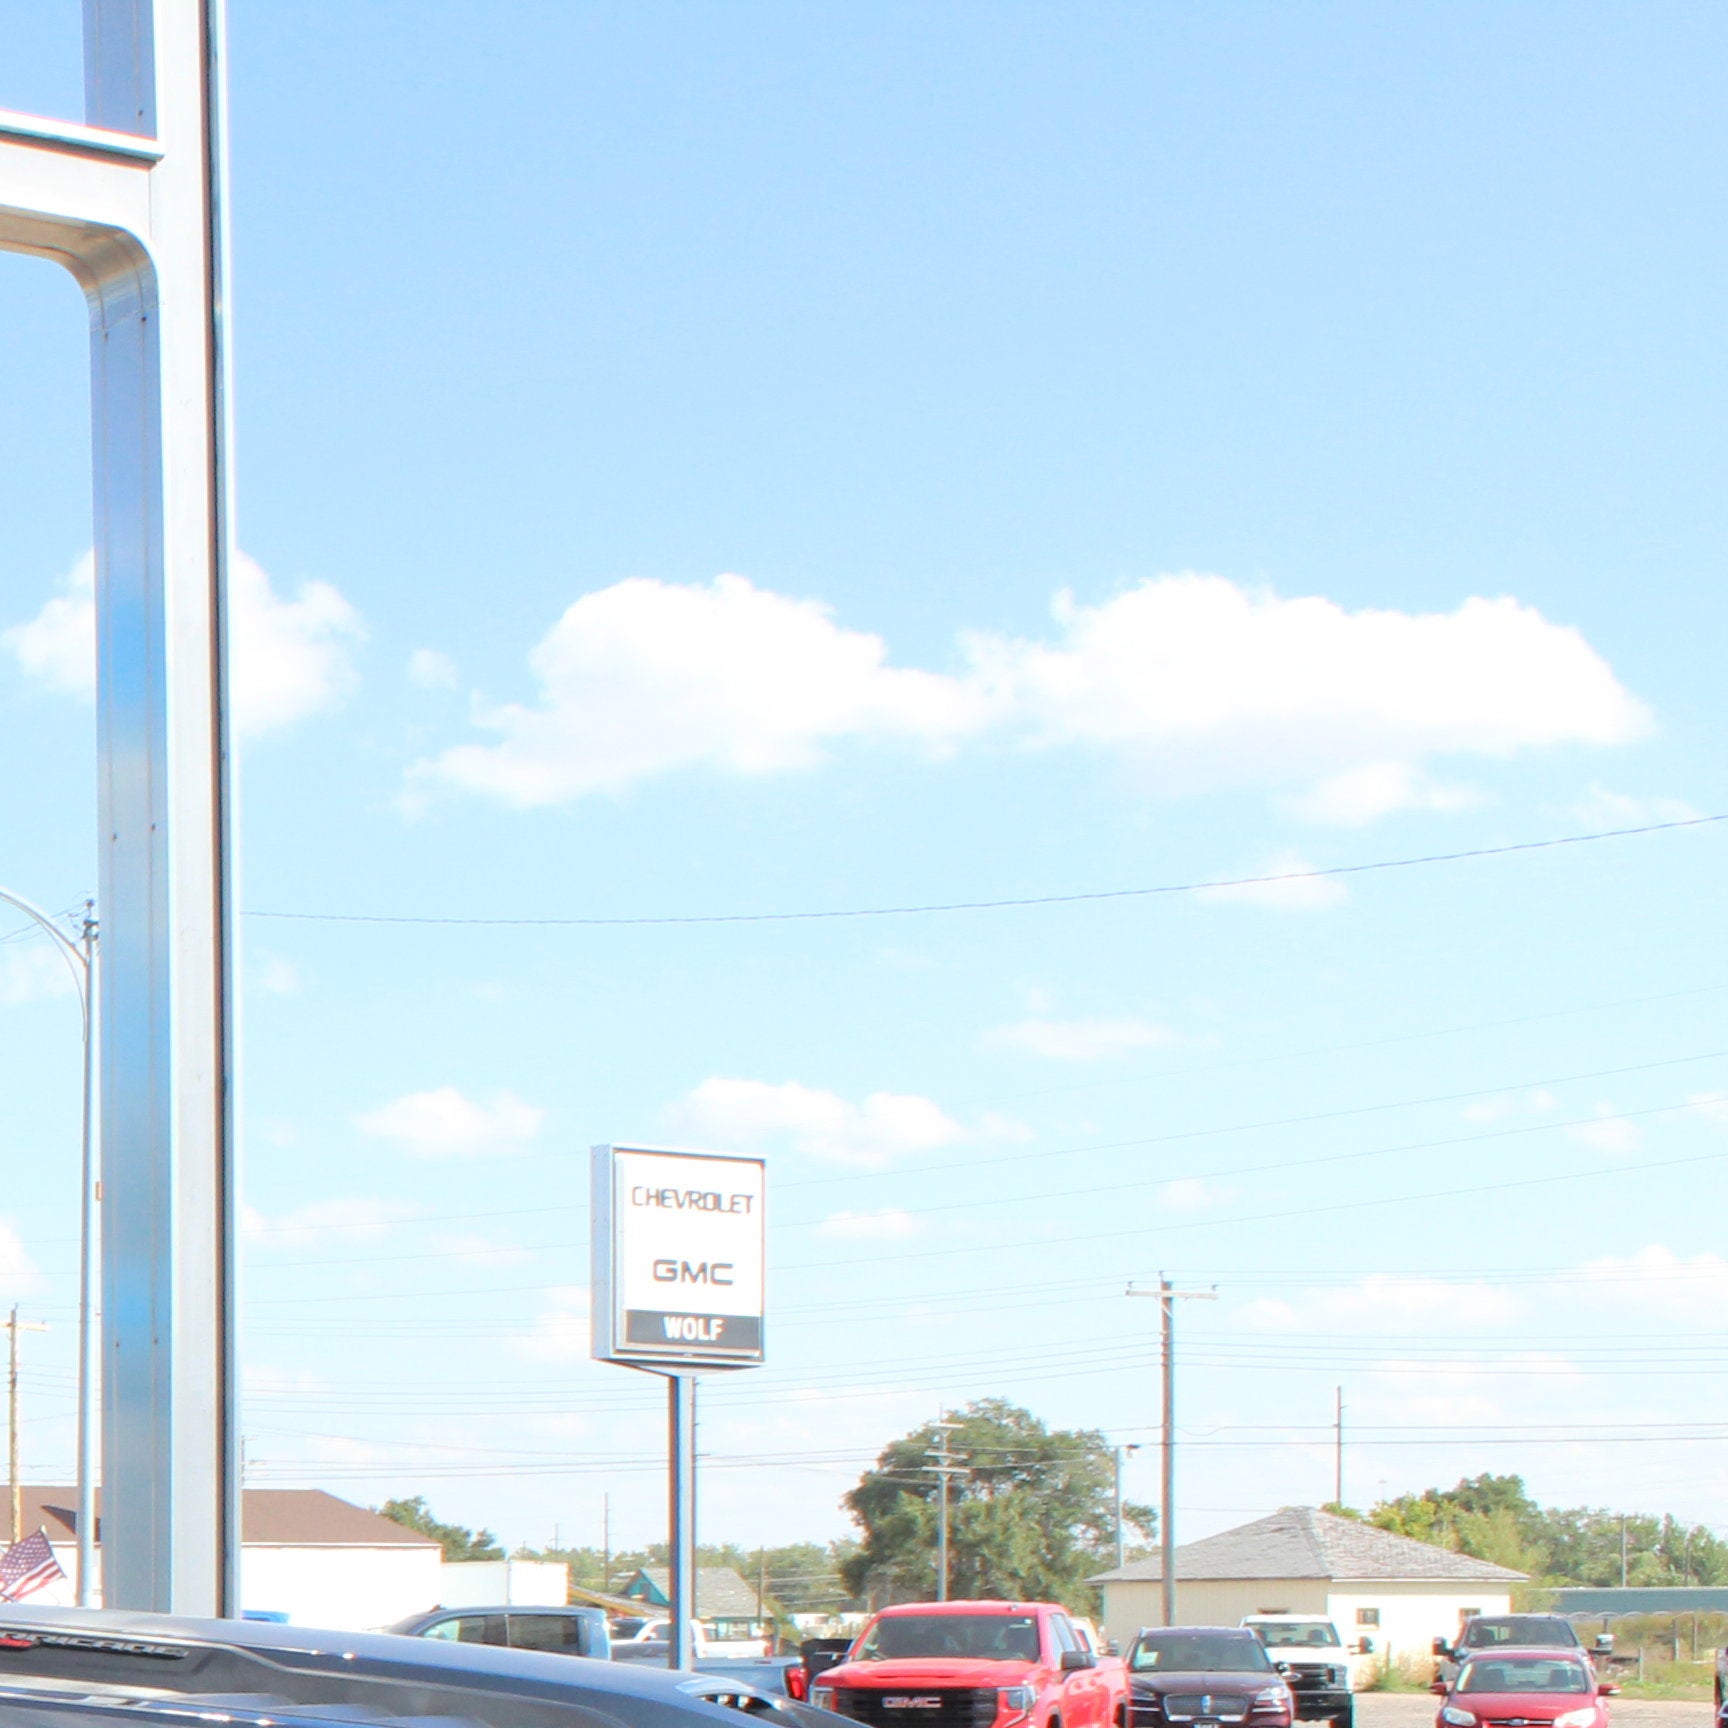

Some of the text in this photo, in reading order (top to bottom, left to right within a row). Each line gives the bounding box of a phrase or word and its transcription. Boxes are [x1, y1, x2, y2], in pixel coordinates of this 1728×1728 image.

[632, 1186, 754, 1214] CHEVROLET
[653, 1259, 733, 1286] GMC
[663, 1316, 726, 1341] WOLF
[882, 1696, 942, 1708] GMC
